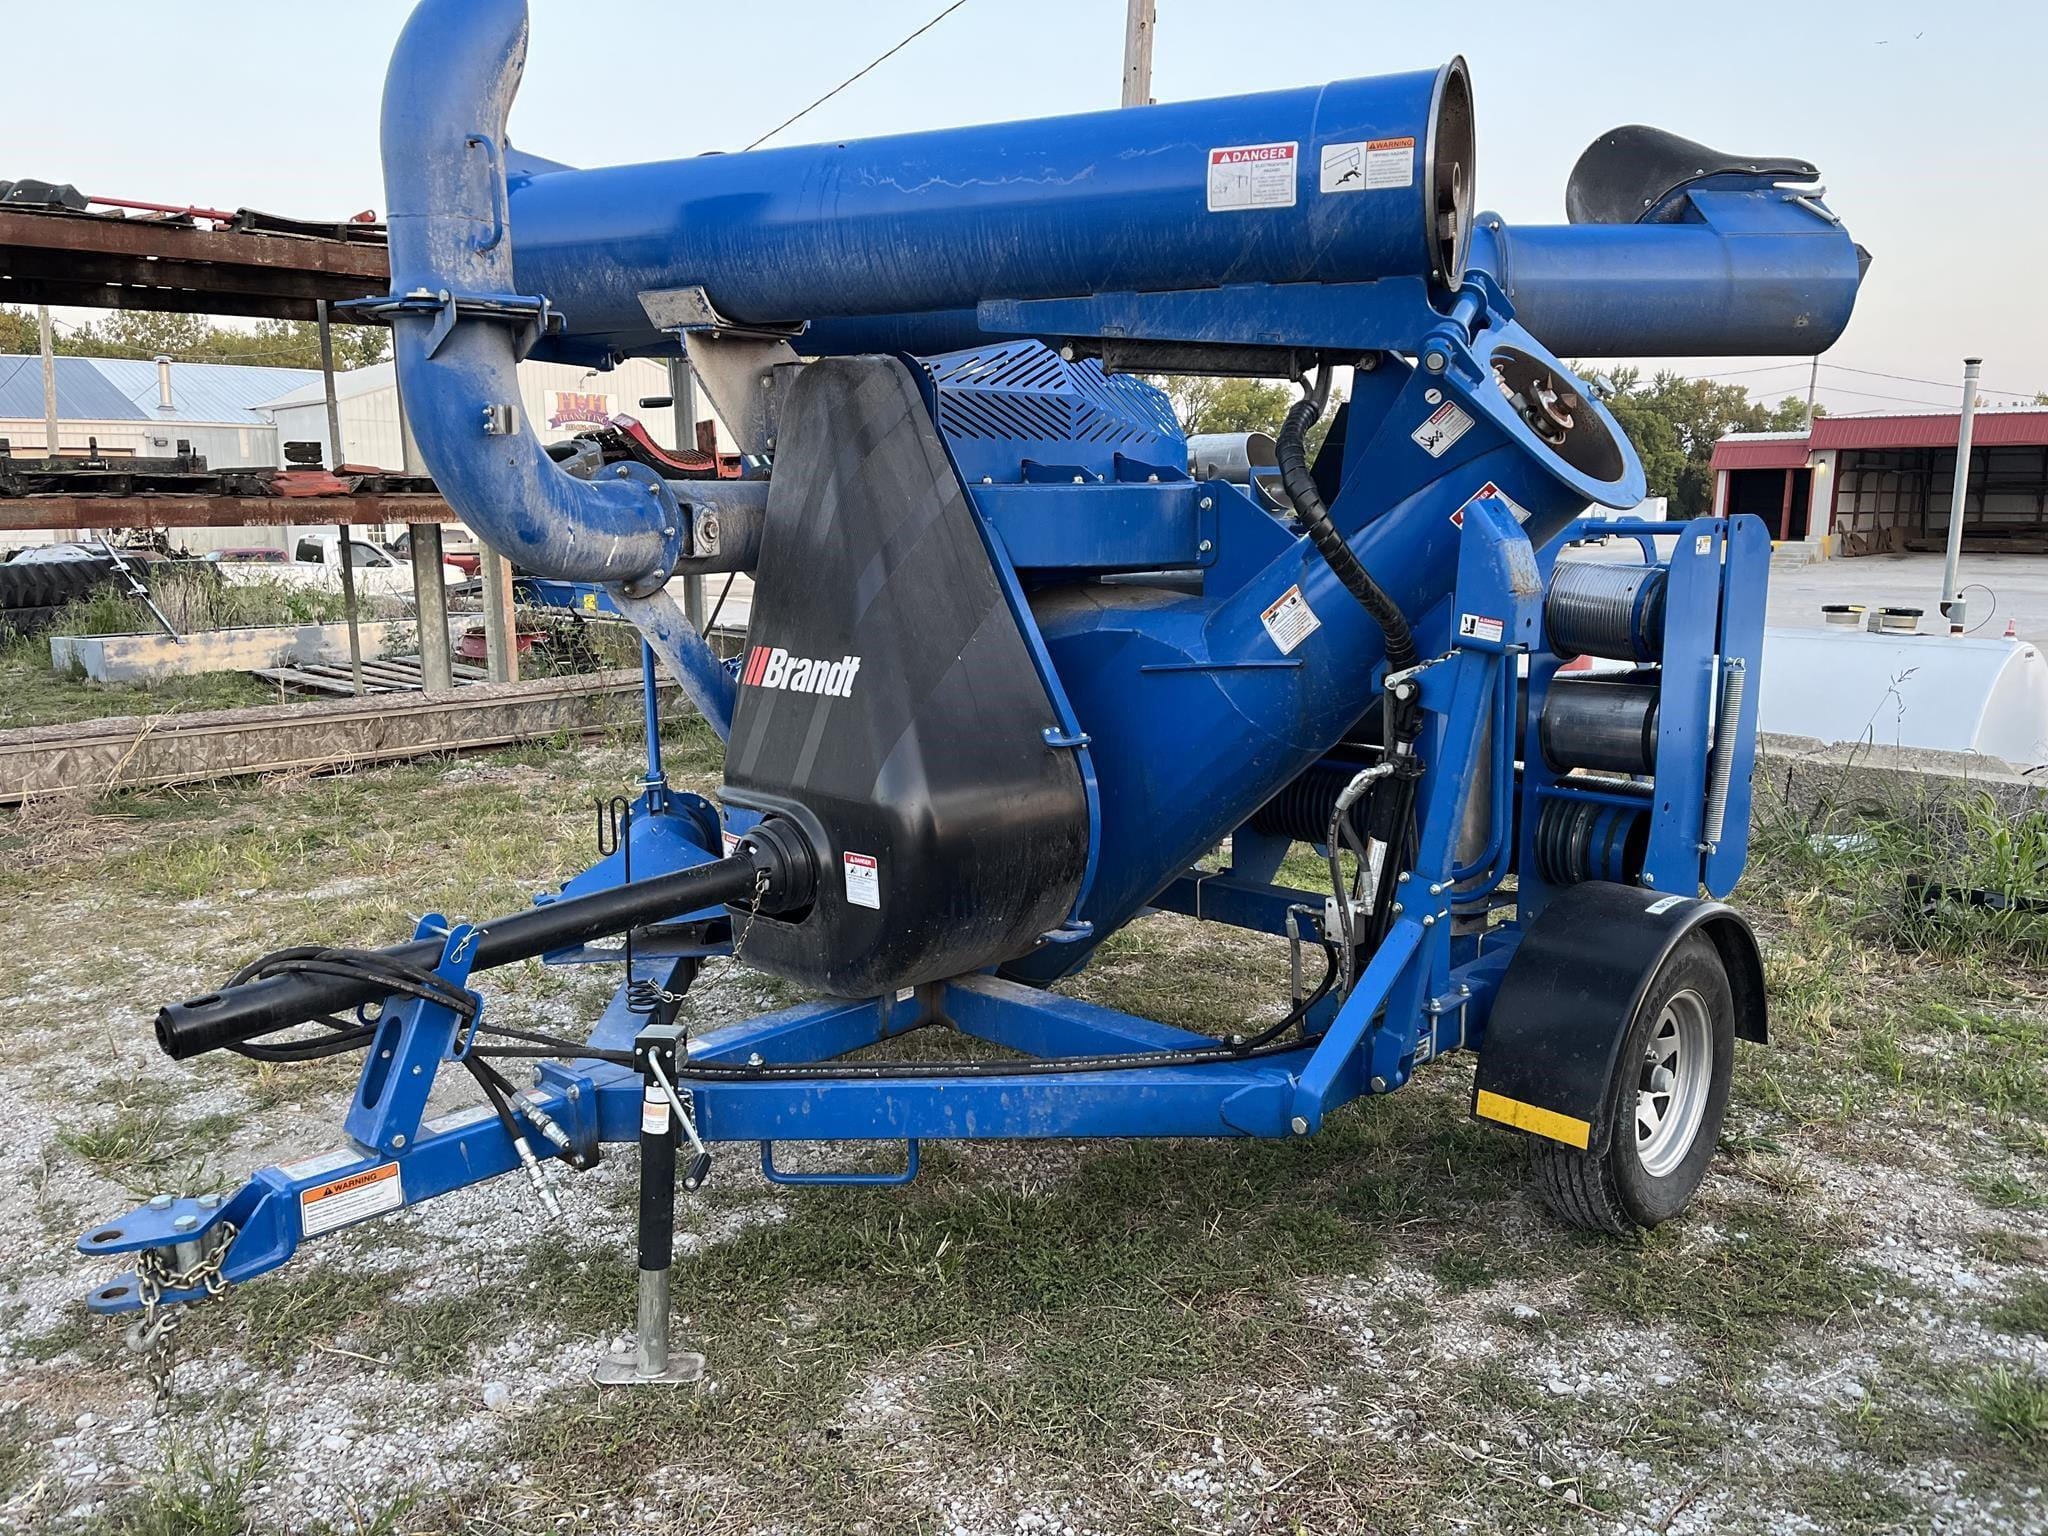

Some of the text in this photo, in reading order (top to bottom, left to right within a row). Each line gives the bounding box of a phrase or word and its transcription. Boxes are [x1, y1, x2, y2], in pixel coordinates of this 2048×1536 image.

[1376, 139, 1412, 150] WARNING
[1232, 148, 1287, 162] DANGER
[761, 648, 861, 698] Brandt
[333, 1173, 377, 1192] WARNING
